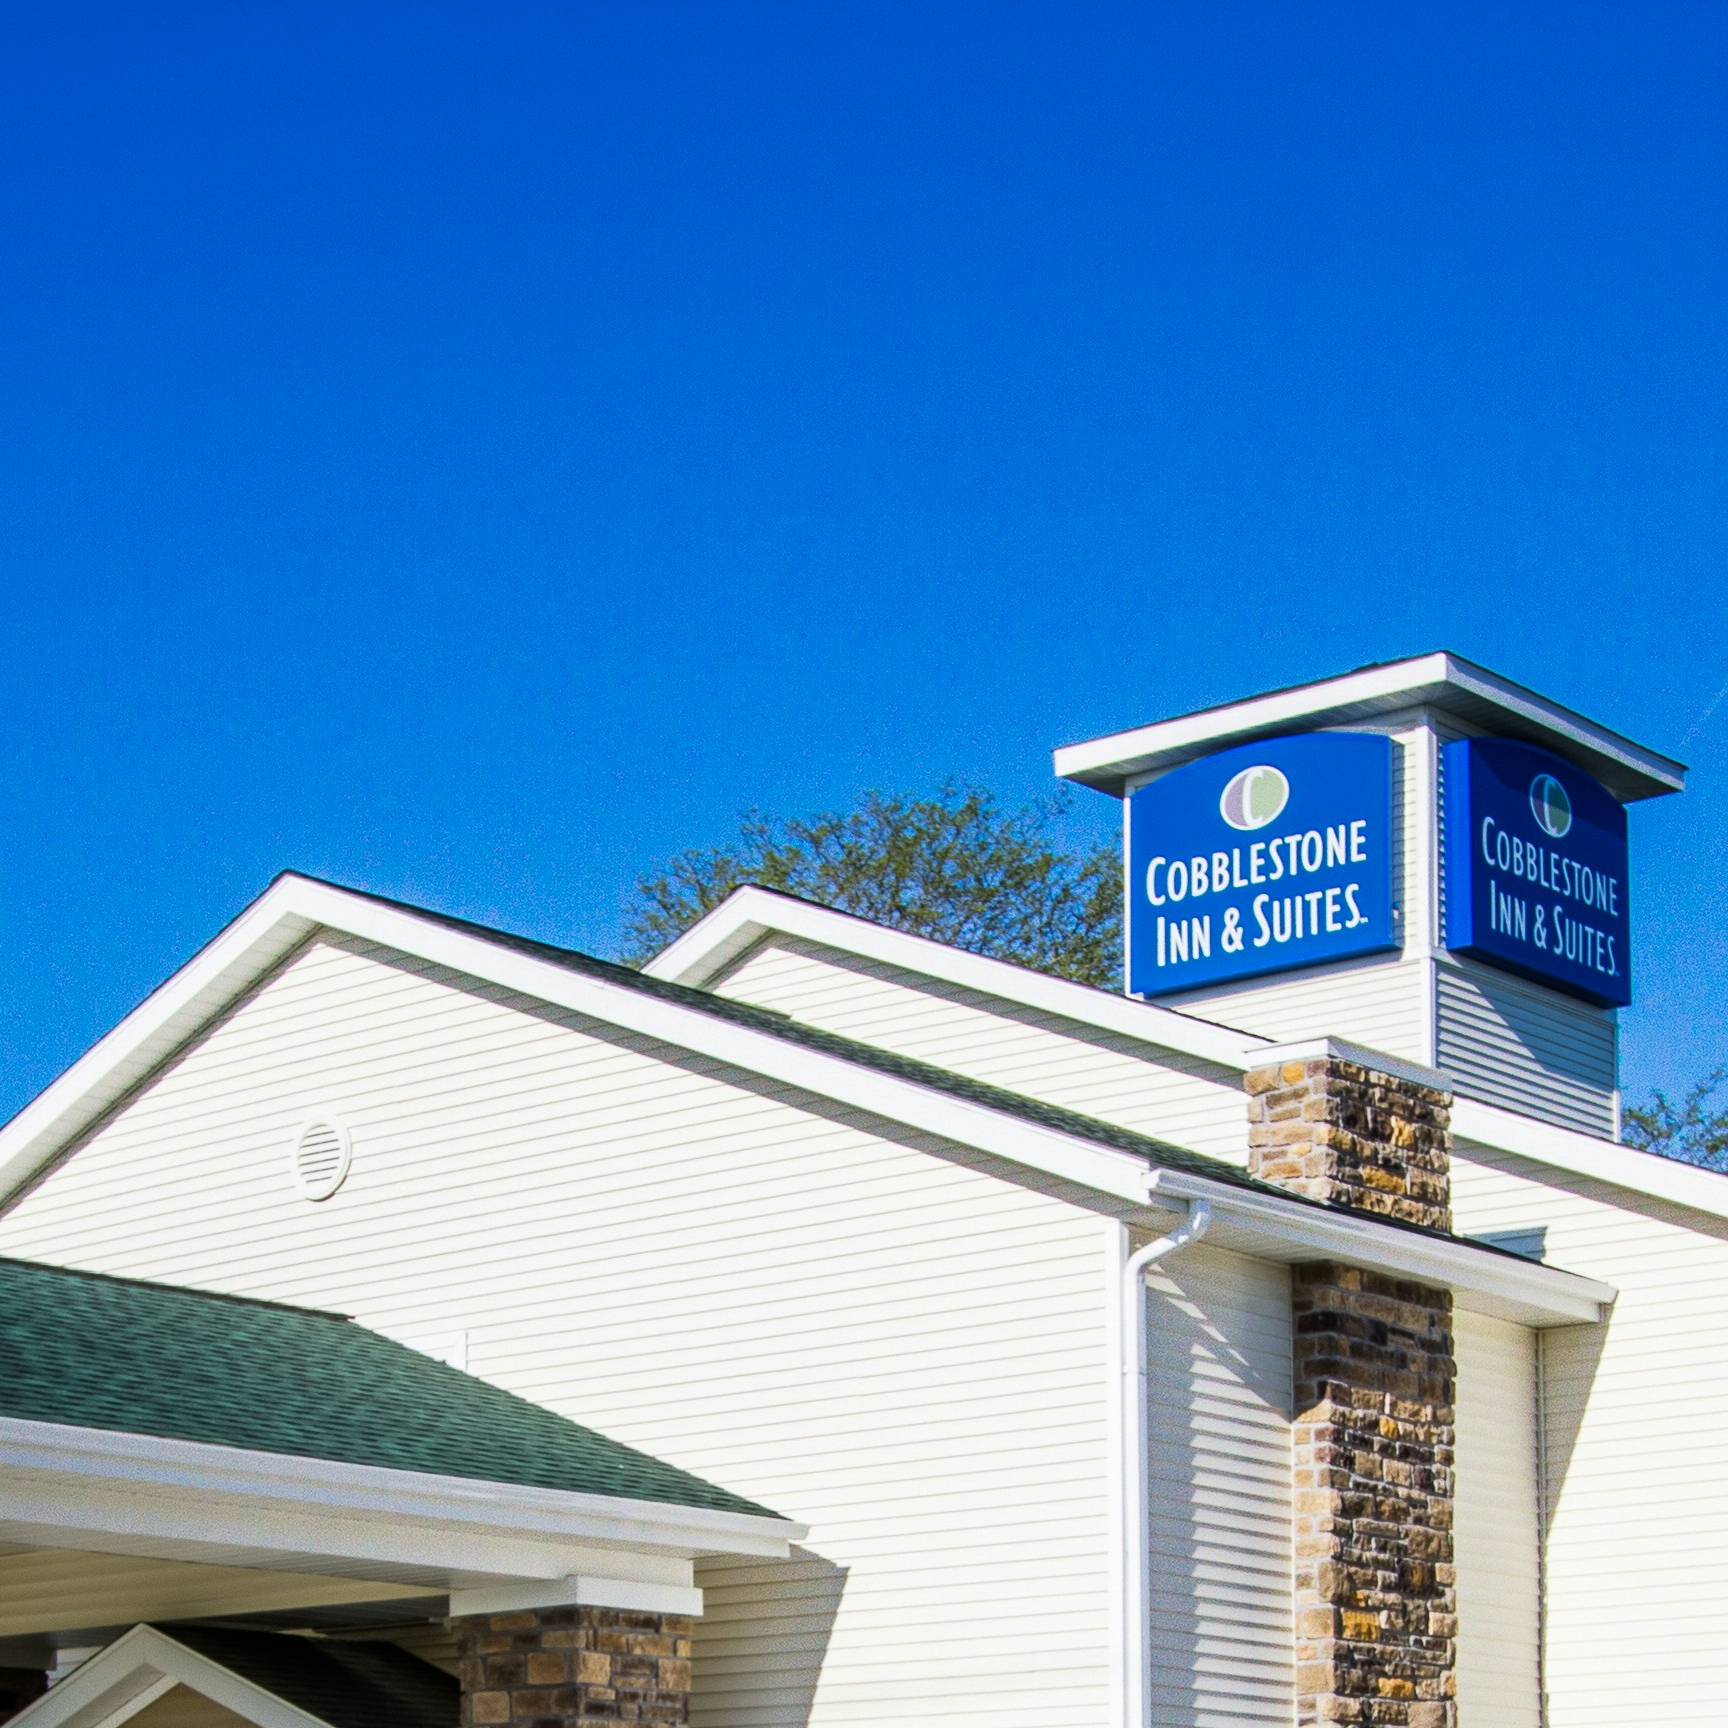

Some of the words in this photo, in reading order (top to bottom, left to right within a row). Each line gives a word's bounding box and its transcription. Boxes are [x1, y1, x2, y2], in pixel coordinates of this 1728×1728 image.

[1146, 819, 1367, 906] COBBLESTONE
[1482, 816, 1618, 917] COBBLESTONE
[1156, 915, 1211, 967] INN
[1221, 907, 1245, 953] &
[1490, 879, 1526, 942] INN
[1533, 904, 1548, 950] &
